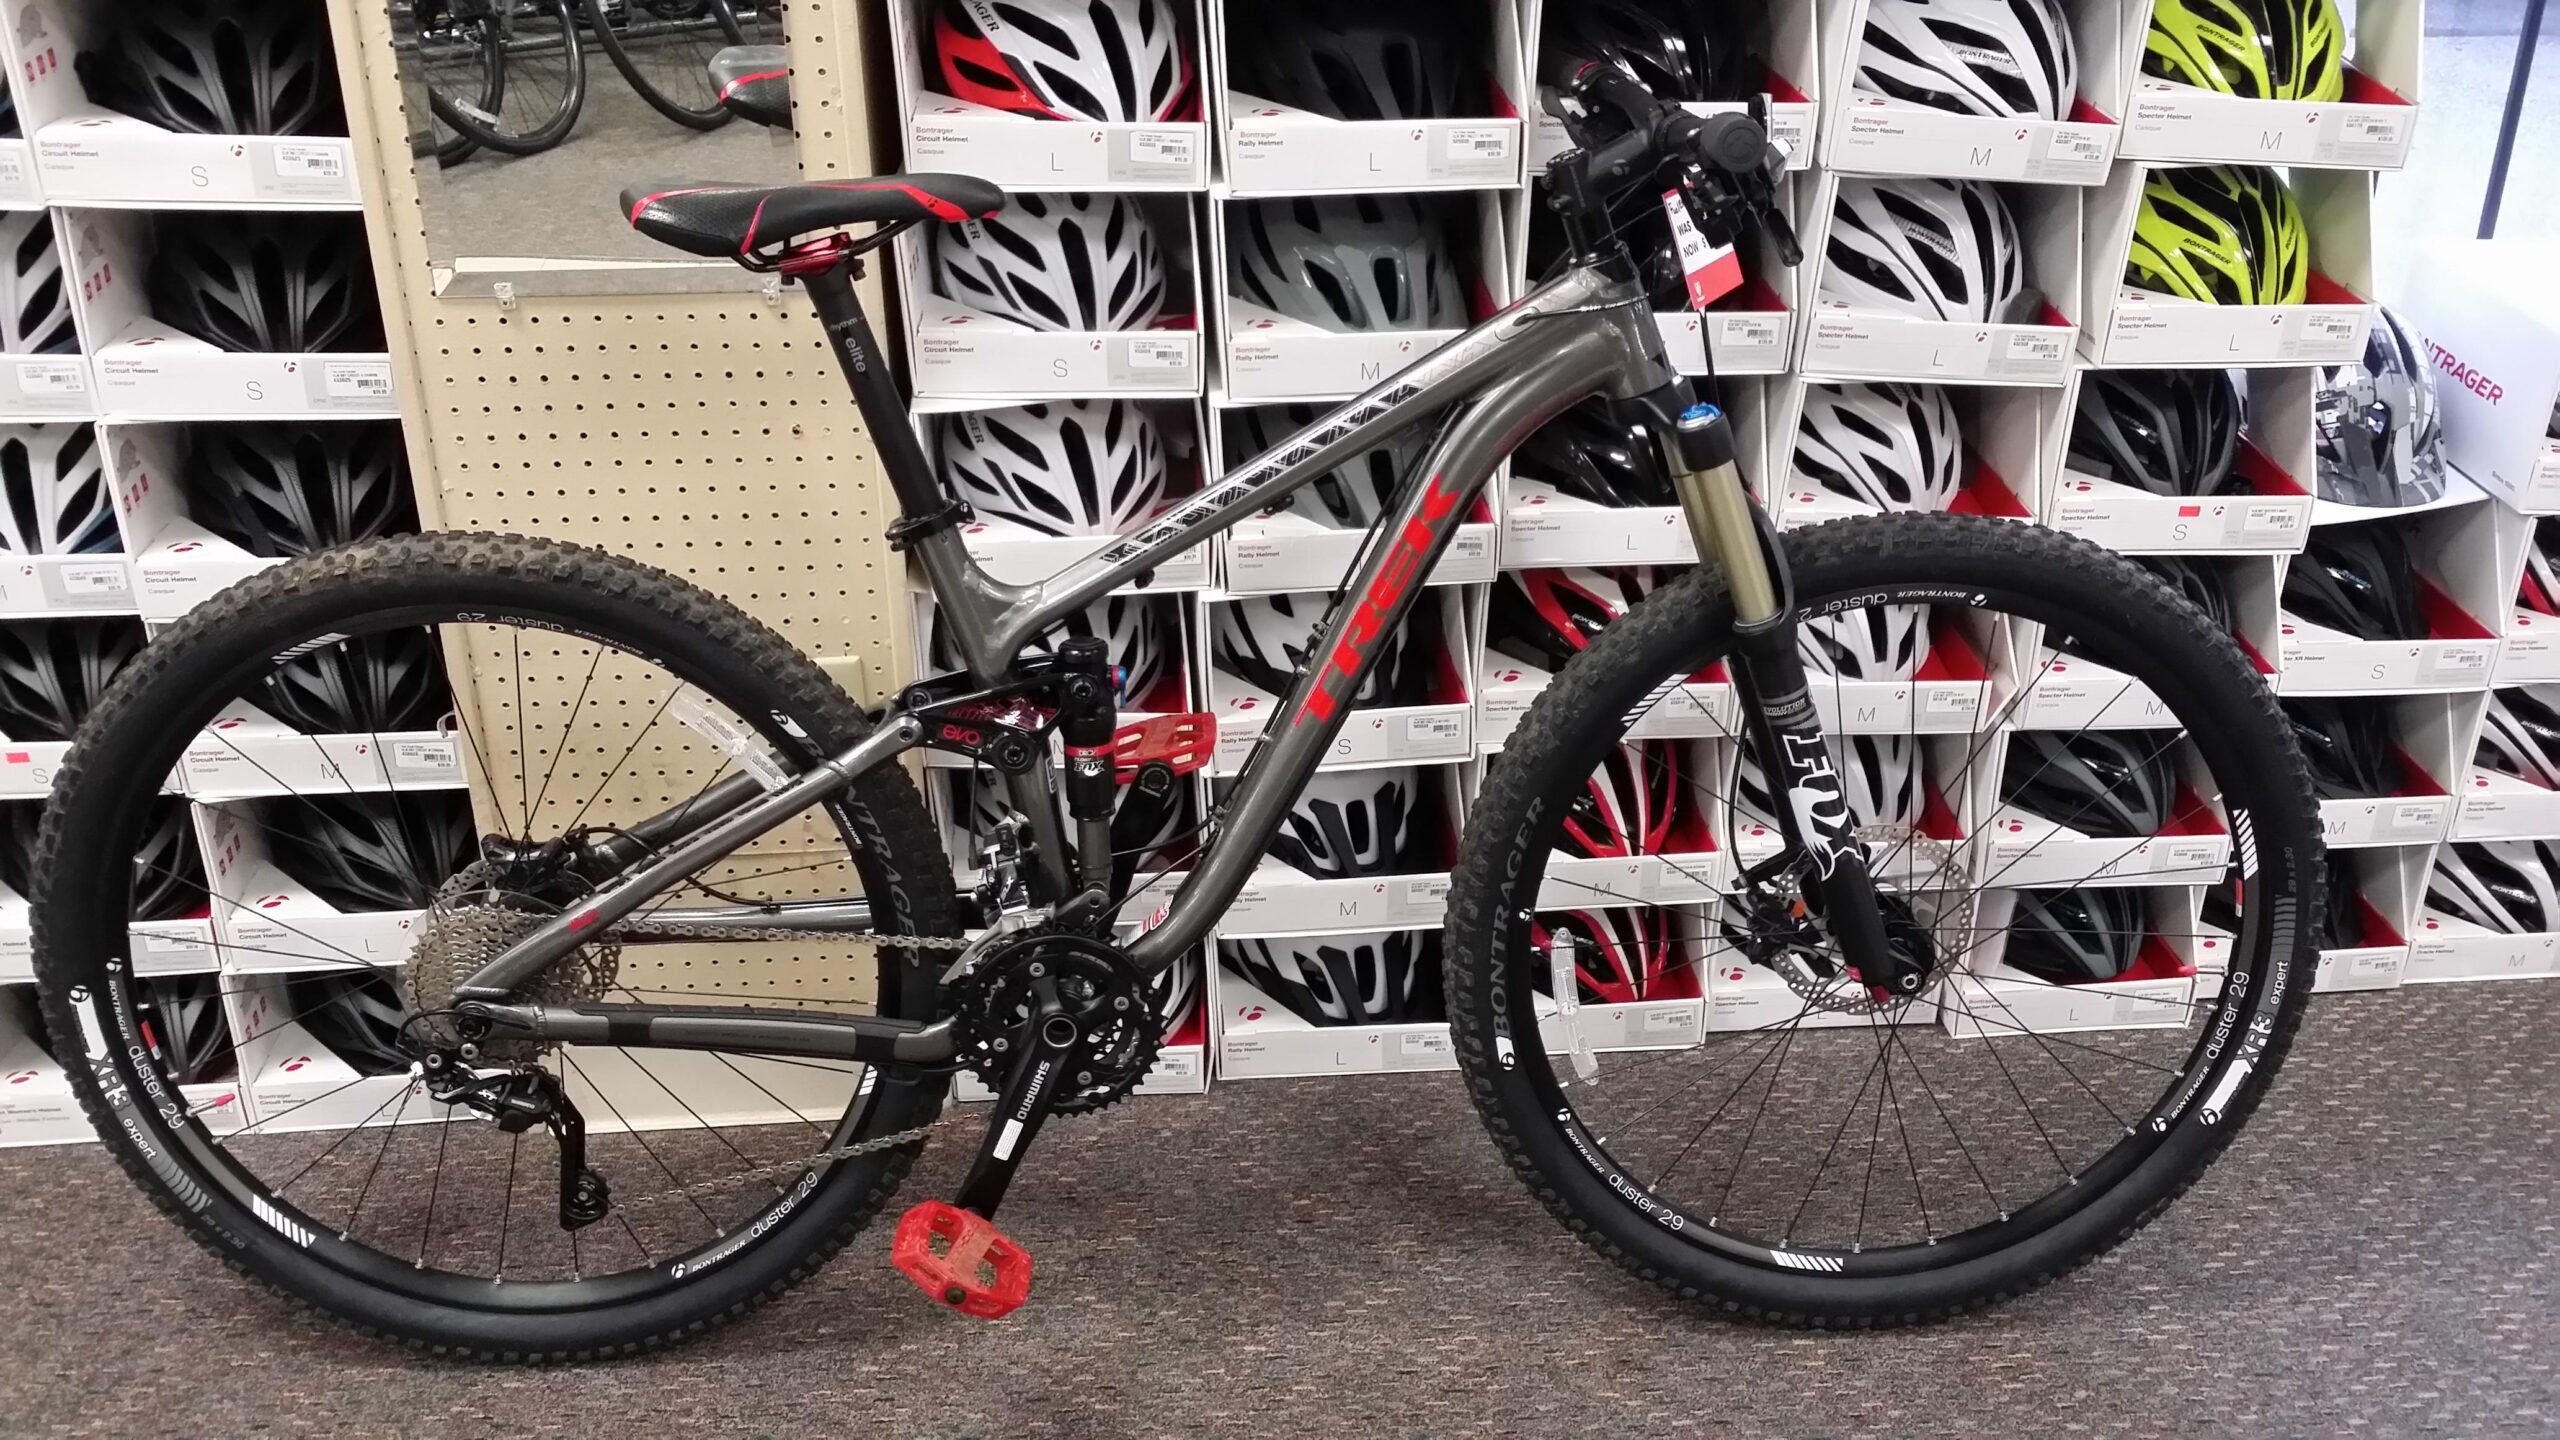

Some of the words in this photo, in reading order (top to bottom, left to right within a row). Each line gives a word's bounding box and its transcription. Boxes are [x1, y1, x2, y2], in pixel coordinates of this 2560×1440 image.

[2196, 24, 2246, 52] BONTRAGER
[2261, 131, 2282, 150] M
[1052, 152, 1064, 171] L
[1370, 152, 1382, 171] L
[1970, 147, 1992, 167] M
[191, 166, 209, 187] S
[1677, 220, 1692, 236] WAS
[1683, 241, 1699, 258] NOW
[1701, 237, 1707, 248] $
[2183, 238, 2232, 265] BONTRAGER
[2229, 334, 2239, 351] L
[845, 336, 866, 373] elite
[1933, 350, 1944, 366] L
[1053, 359, 1068, 378] S
[1361, 362, 1380, 380] M
[2424, 338, 2504, 406] NTRAGER
[246, 380, 264, 401] S
[1627, 533, 1638, 550] L
[2173, 524, 2188, 541] S
[1294, 471, 1461, 727] TREK
[1823, 592, 1888, 613] duster
[1897, 590, 1967, 599] BONTRAGER
[457, 612, 486, 624] 29
[499, 615, 565, 633] duster
[1798, 608, 1813, 622] 2
[2371, 664, 2385, 680] S
[1857, 707, 1876, 722] M
[2145, 701, 2164, 715] M
[942, 723, 981, 745] evo
[1338, 739, 1352, 755] S
[33, 768, 50, 785] S
[321, 762, 341, 779] M
[1074, 760, 1104, 777] FOX
[2328, 821, 2346, 835] M
[2100, 860, 2118, 875] M
[1594, 882, 1610, 896] M
[1340, 901, 1357, 916] M
[1490, 795, 1545, 1037] BONTRAGER
[364, 938, 378, 953] L
[2508, 954, 2526, 967] M
[2270, 960, 2289, 1005] expert
[2069, 1008, 2079, 1021] L
[108, 980, 131, 1041] BONTRAGER
[129, 1045, 165, 1100] duster
[158, 1102, 185, 1129] 29
[2170, 1065, 2211, 1120] BONTRAGER
[2206, 1002, 2239, 1060] duster
[2229, 971, 2250, 998] 29
[1336, 1052, 1347, 1066] L
[1017, 1061, 1050, 1121] SHIMANO
[123, 1118, 157, 1160] expert
[1565, 1127, 1605, 1174] BONTRAGER
[1608, 1172, 1657, 1213] duster
[1658, 1208, 1684, 1231] 29
[691, 1238, 746, 1272] BONTRAGER
[750, 1196, 796, 1239] duster
[796, 1171, 819, 1198] 29
